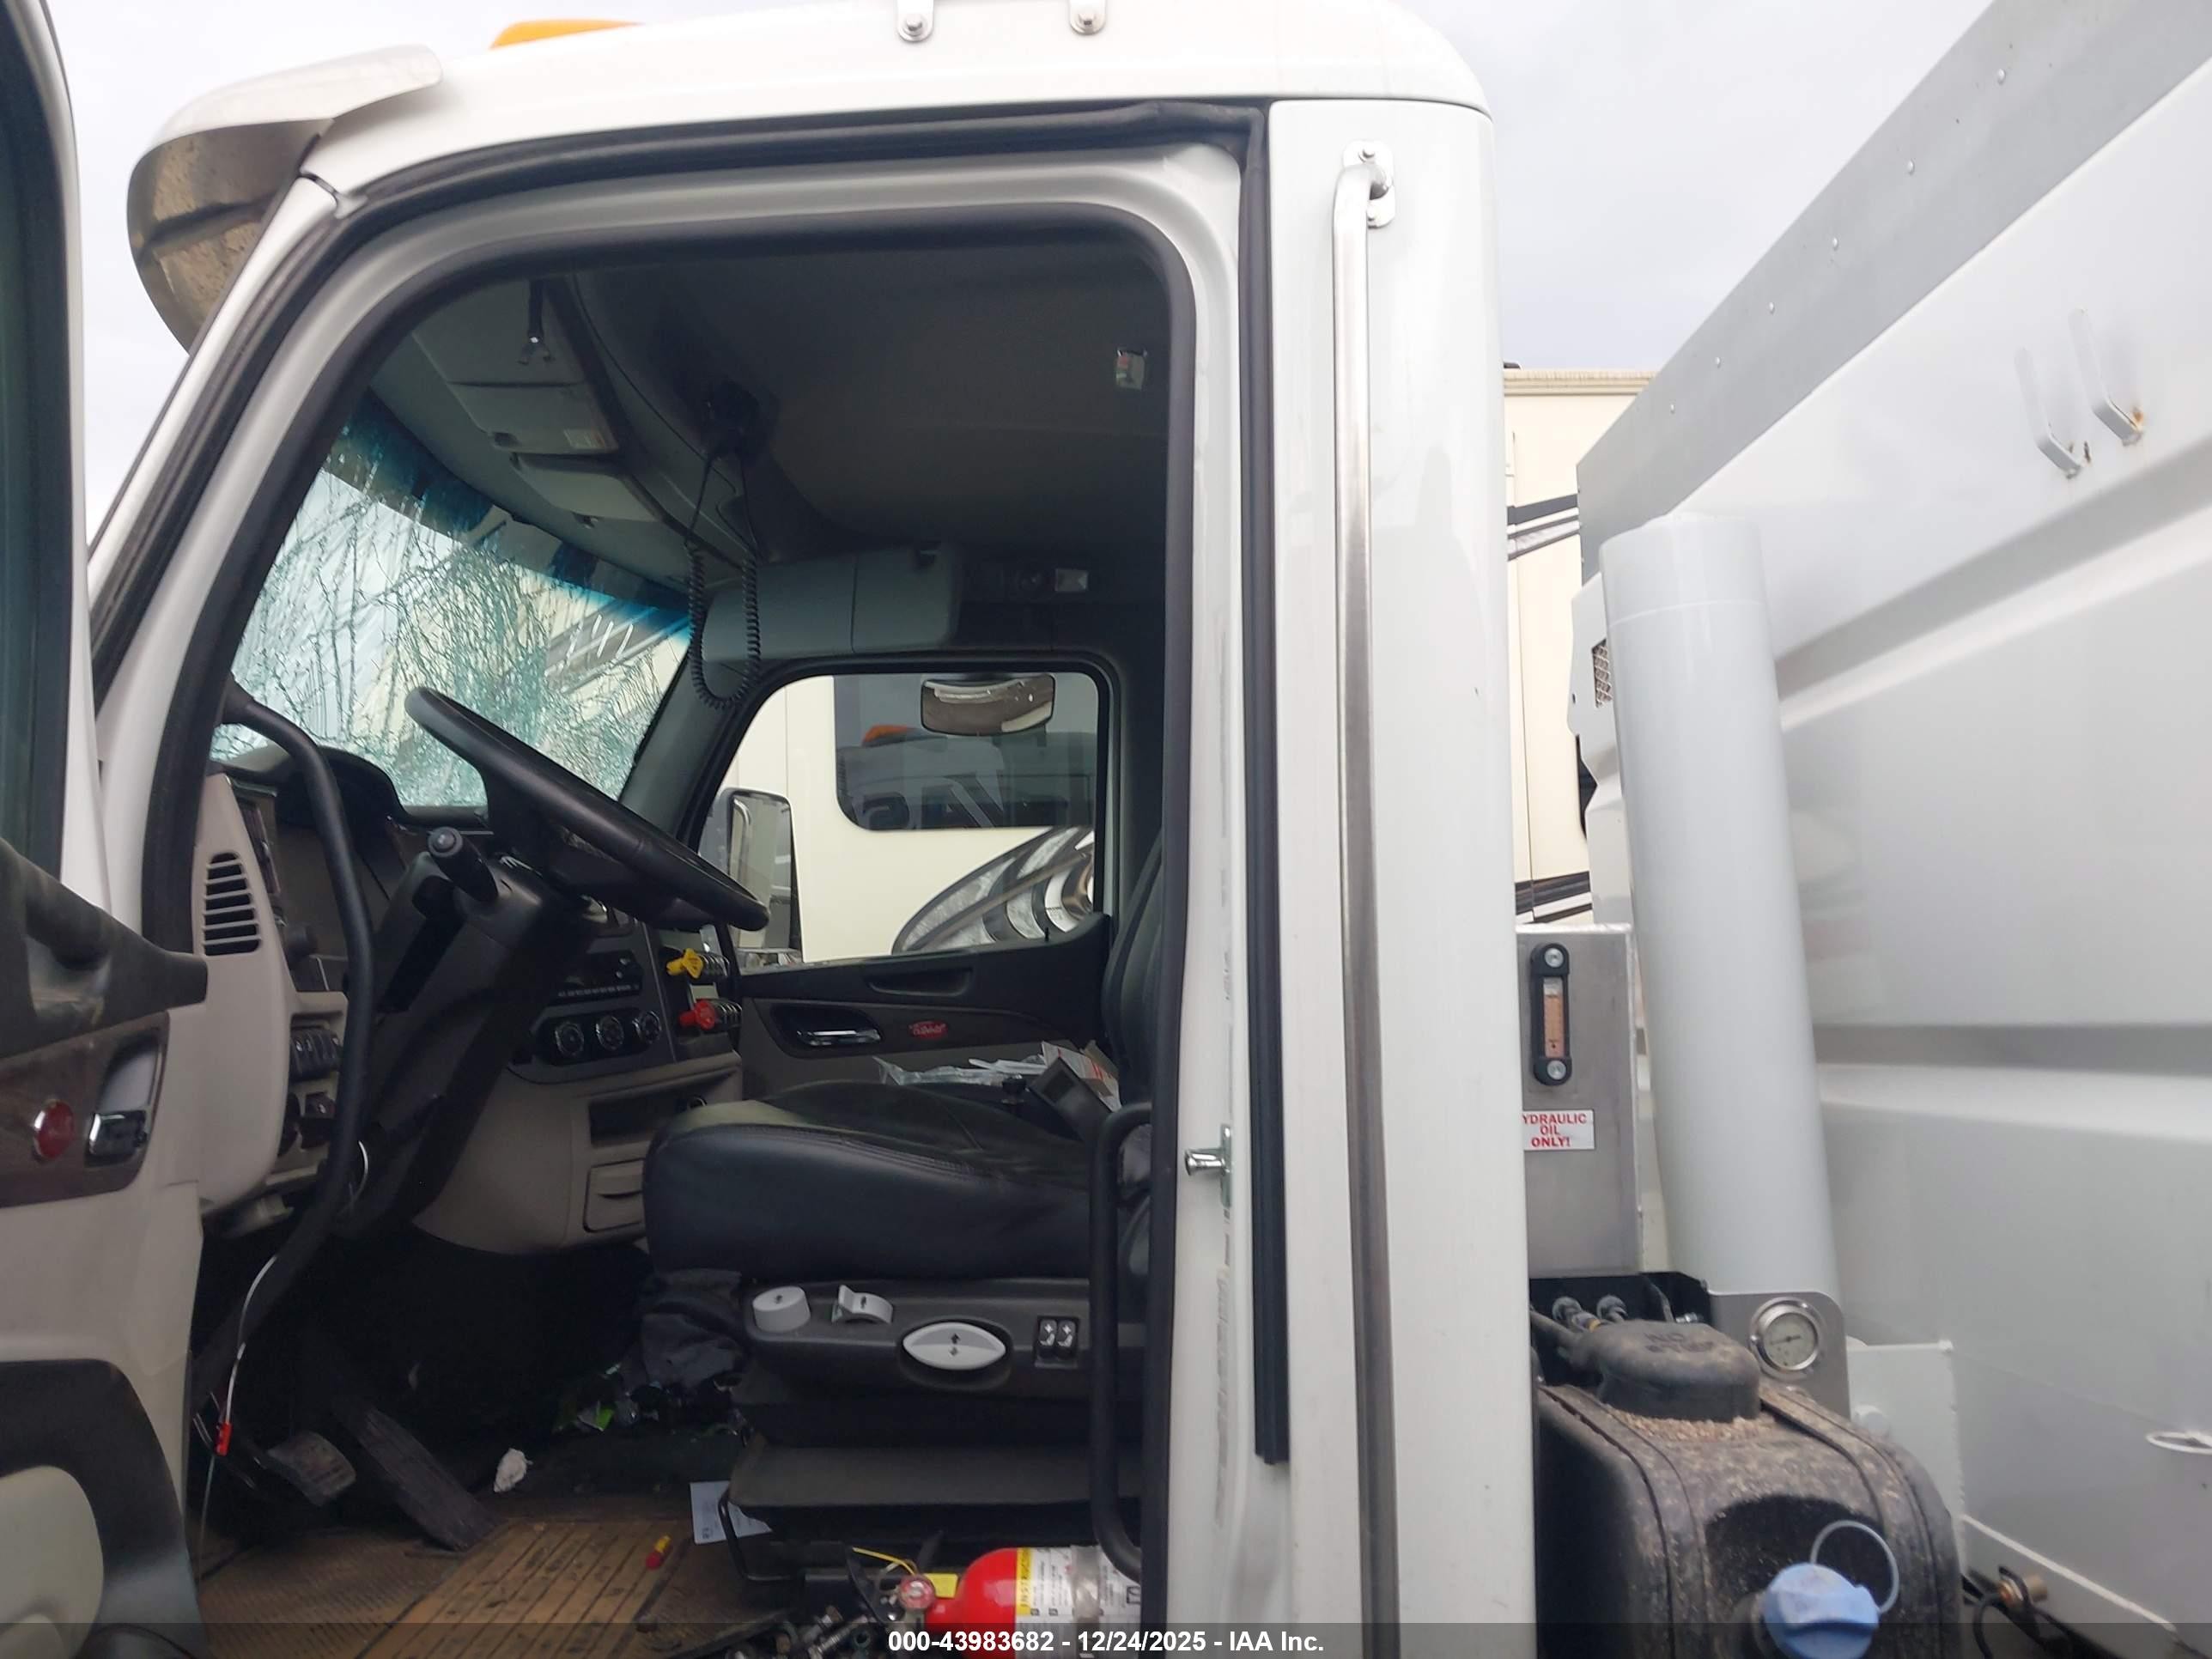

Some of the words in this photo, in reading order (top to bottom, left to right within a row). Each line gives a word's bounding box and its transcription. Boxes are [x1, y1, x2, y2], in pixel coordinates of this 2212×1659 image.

[1522, 1113, 1587, 1124] YDRAULIC
[1540, 1125, 1560, 1135] OIL
[1531, 1137, 1571, 1147] ONLY!
